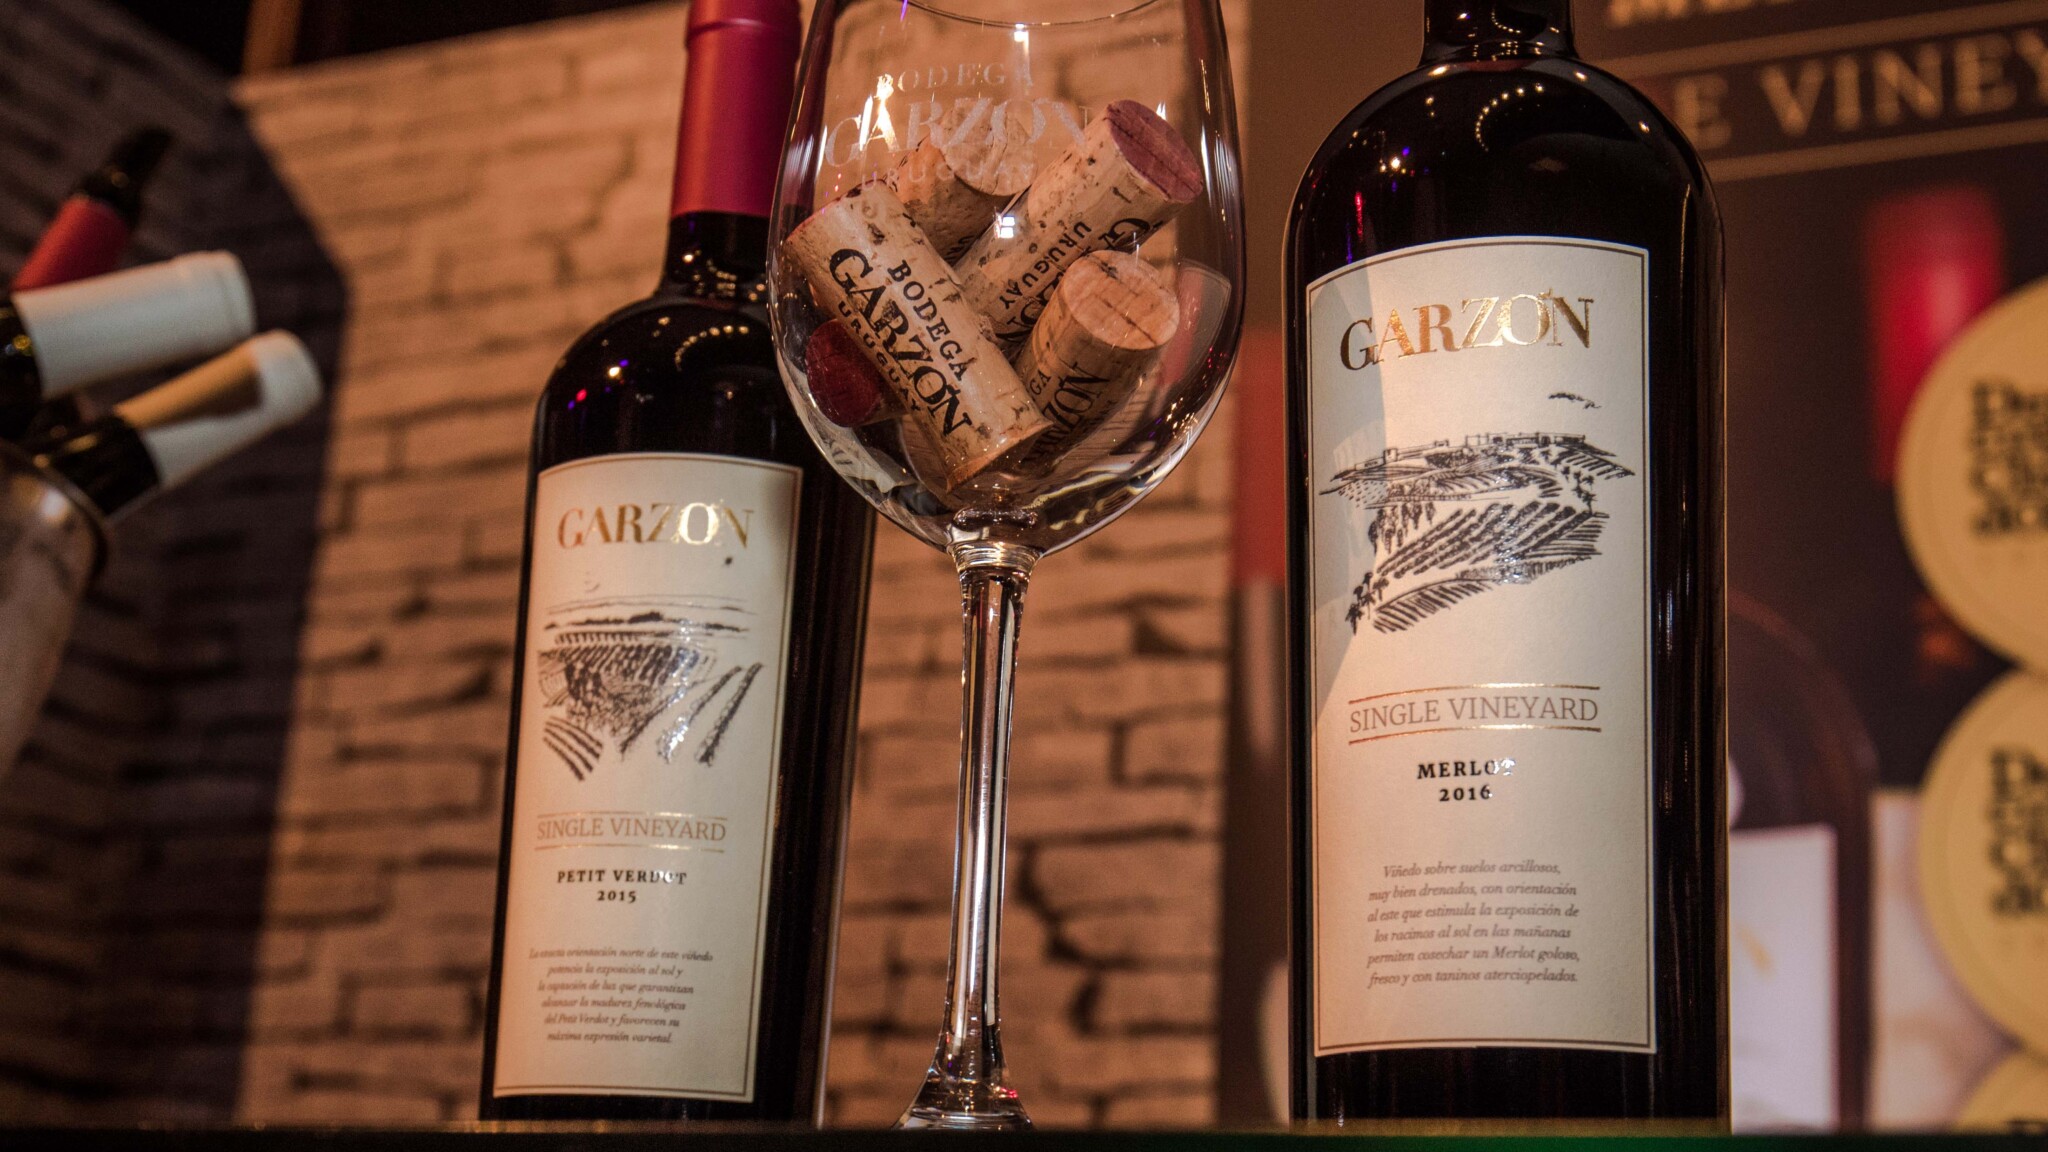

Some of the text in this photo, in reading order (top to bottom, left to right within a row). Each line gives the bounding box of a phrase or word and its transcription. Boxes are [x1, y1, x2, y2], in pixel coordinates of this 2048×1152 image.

[999, 221, 1092, 310] URUGUAY
[887, 259, 977, 382] BODEGA
[836, 300, 921, 412] URUGUAY
[1350, 696, 1598, 733] SINGLE VINEYARD
[1439, 784, 1492, 802] 2016
[537, 817, 726, 841] SINGLE VINEYARD
[557, 869, 687, 885] PETIT VERDOT
[1384, 864, 1421, 878] Viñedo
[1424, 862, 1456, 875] sobre
[1459, 860, 1495, 874] suelos
[597, 890, 637, 903] 2015
[1369, 890, 1391, 903] muy
[1393, 886, 1416, 899] bien
[1481, 885, 1502, 894] con
[1507, 883, 1576, 896] orientación
[1368, 902, 1579, 923] al este que estimula la exposición de
[1374, 924, 1571, 943] los racimos al sol en las mañanas
[1367, 952, 1414, 968] permiten
[1417, 949, 1469, 961] cosechar
[1473, 951, 1488, 959] un
[1492, 947, 1535, 959] Merlot
[1367, 972, 1401, 989] fresco
[1401, 975, 1410, 986] y
[1412, 972, 1432, 982] con
[1435, 968, 1480, 982] taninos
